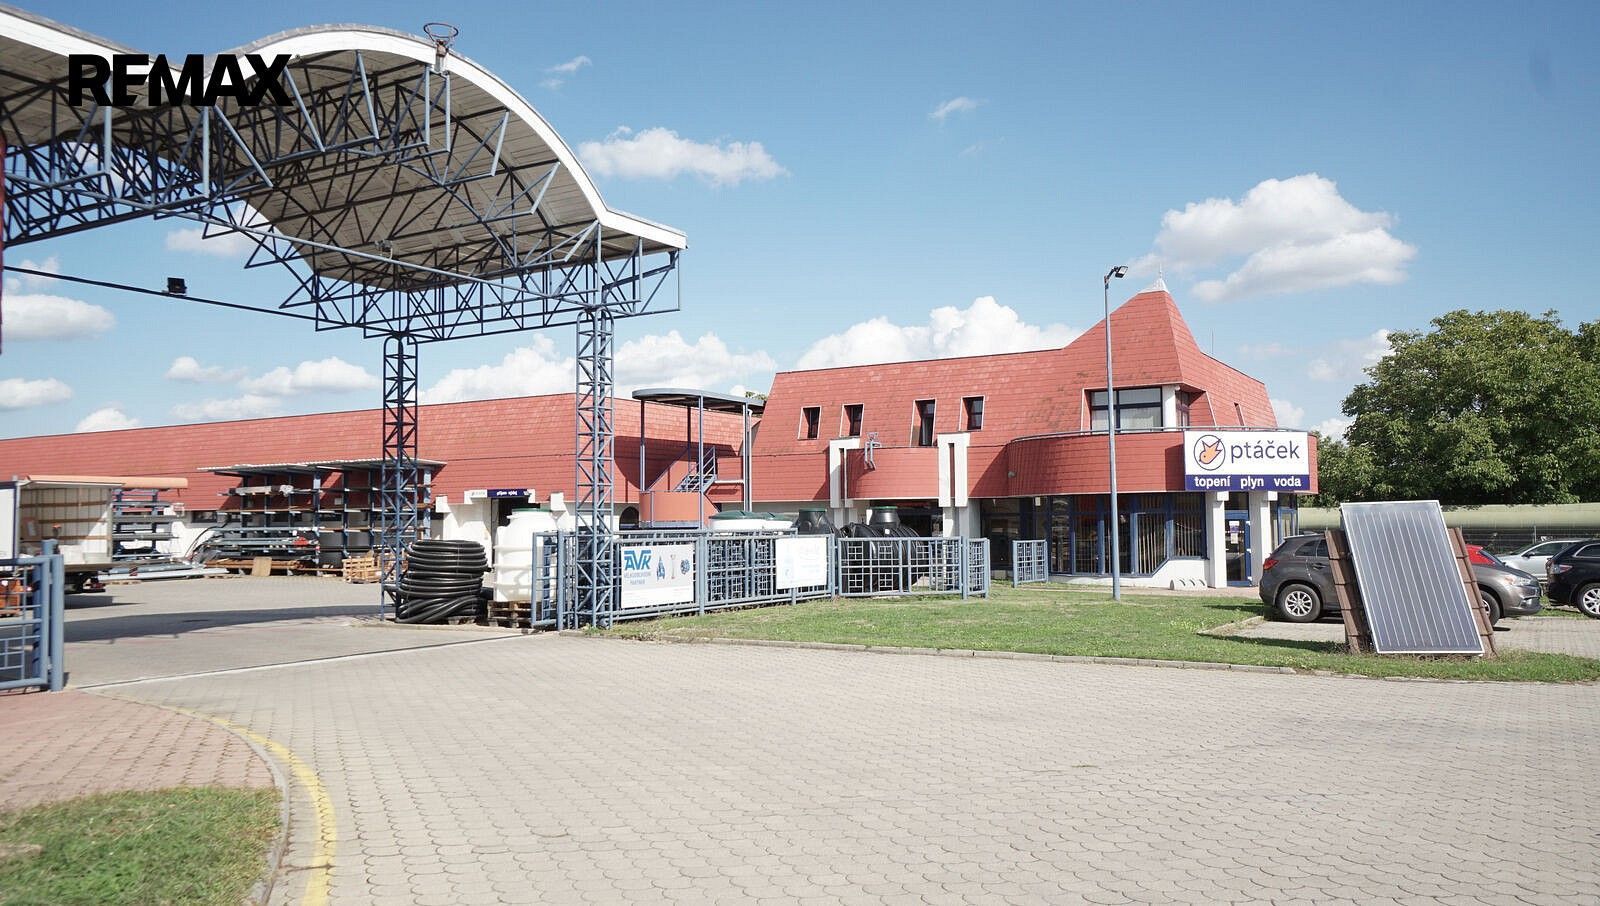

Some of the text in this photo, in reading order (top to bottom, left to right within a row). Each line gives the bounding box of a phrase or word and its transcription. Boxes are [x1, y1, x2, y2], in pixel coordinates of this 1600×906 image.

[1231, 440, 1300, 463] ptáček
[1194, 476, 1302, 489] topení plyn voda
[624, 550, 651, 570] AVK
